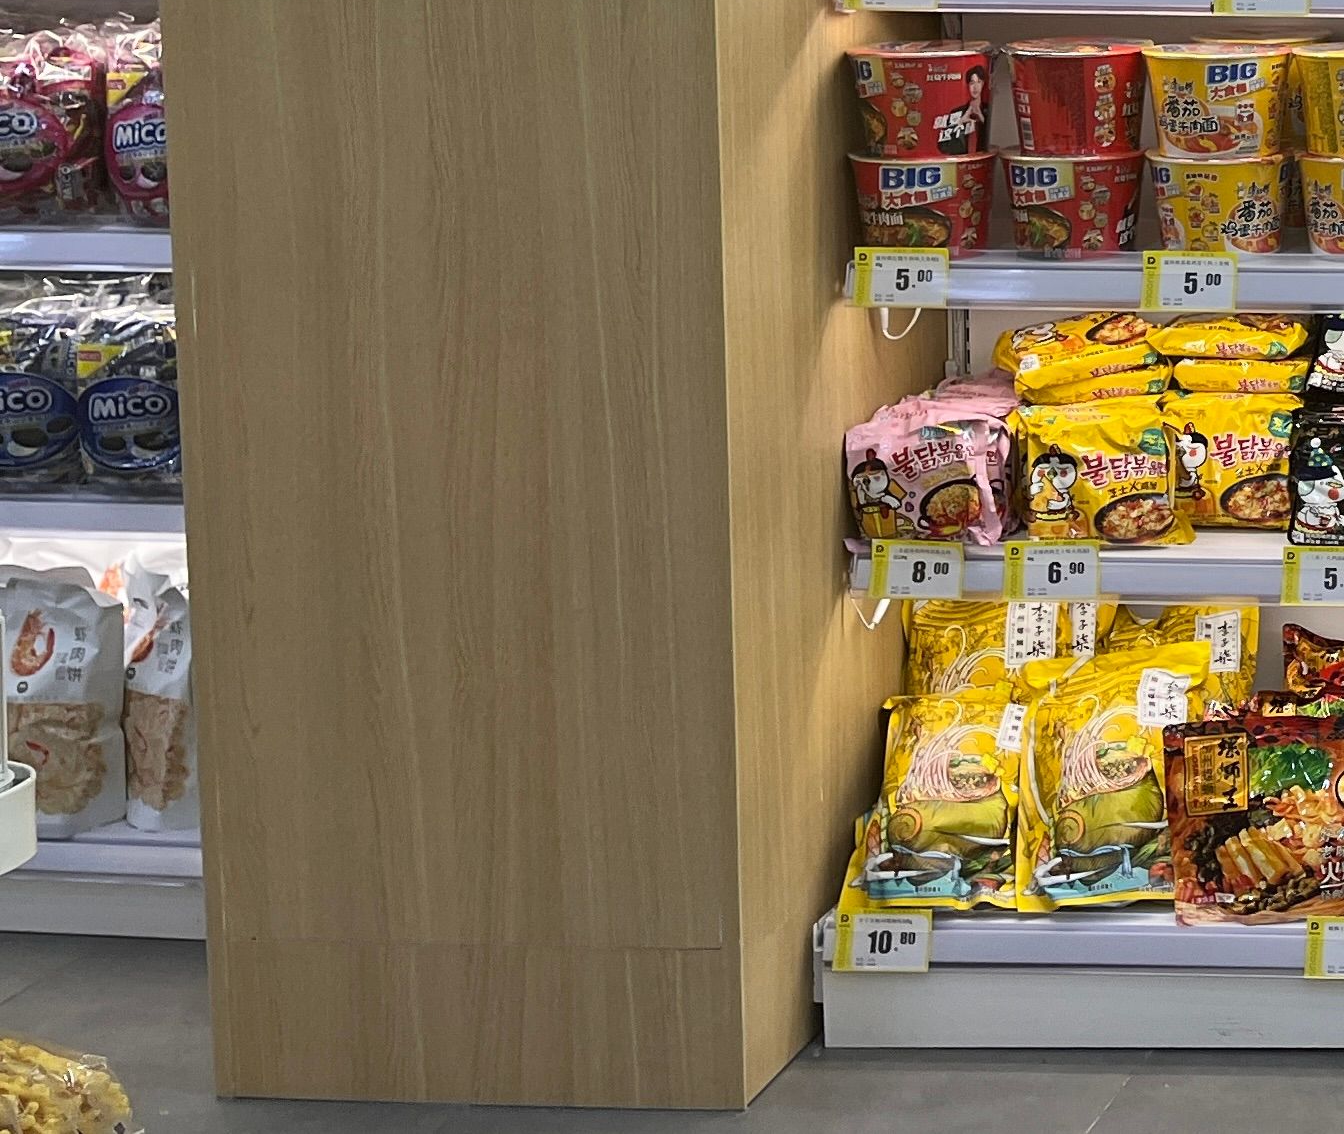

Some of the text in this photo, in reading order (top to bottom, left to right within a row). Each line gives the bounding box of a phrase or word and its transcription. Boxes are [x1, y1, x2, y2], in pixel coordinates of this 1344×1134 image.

[1206, 63, 1258, 85] BIG
[1163, 97, 1201, 117] 番茄
[1159, 116, 1219, 135] 鸡蛋牛肉面
[879, 166, 943, 190] BIG
[1236, 201, 1272, 219] 番茄
[1220, 217, 1281, 238] 鸡蛋牛肉面
[895, 269, 932, 292] 5.00
[1183, 272, 1221, 295] 5.00
[91, 391, 169, 421] Mico
[912, 561, 949, 585] 8.00
[1048, 562, 1085, 584] 6.90
